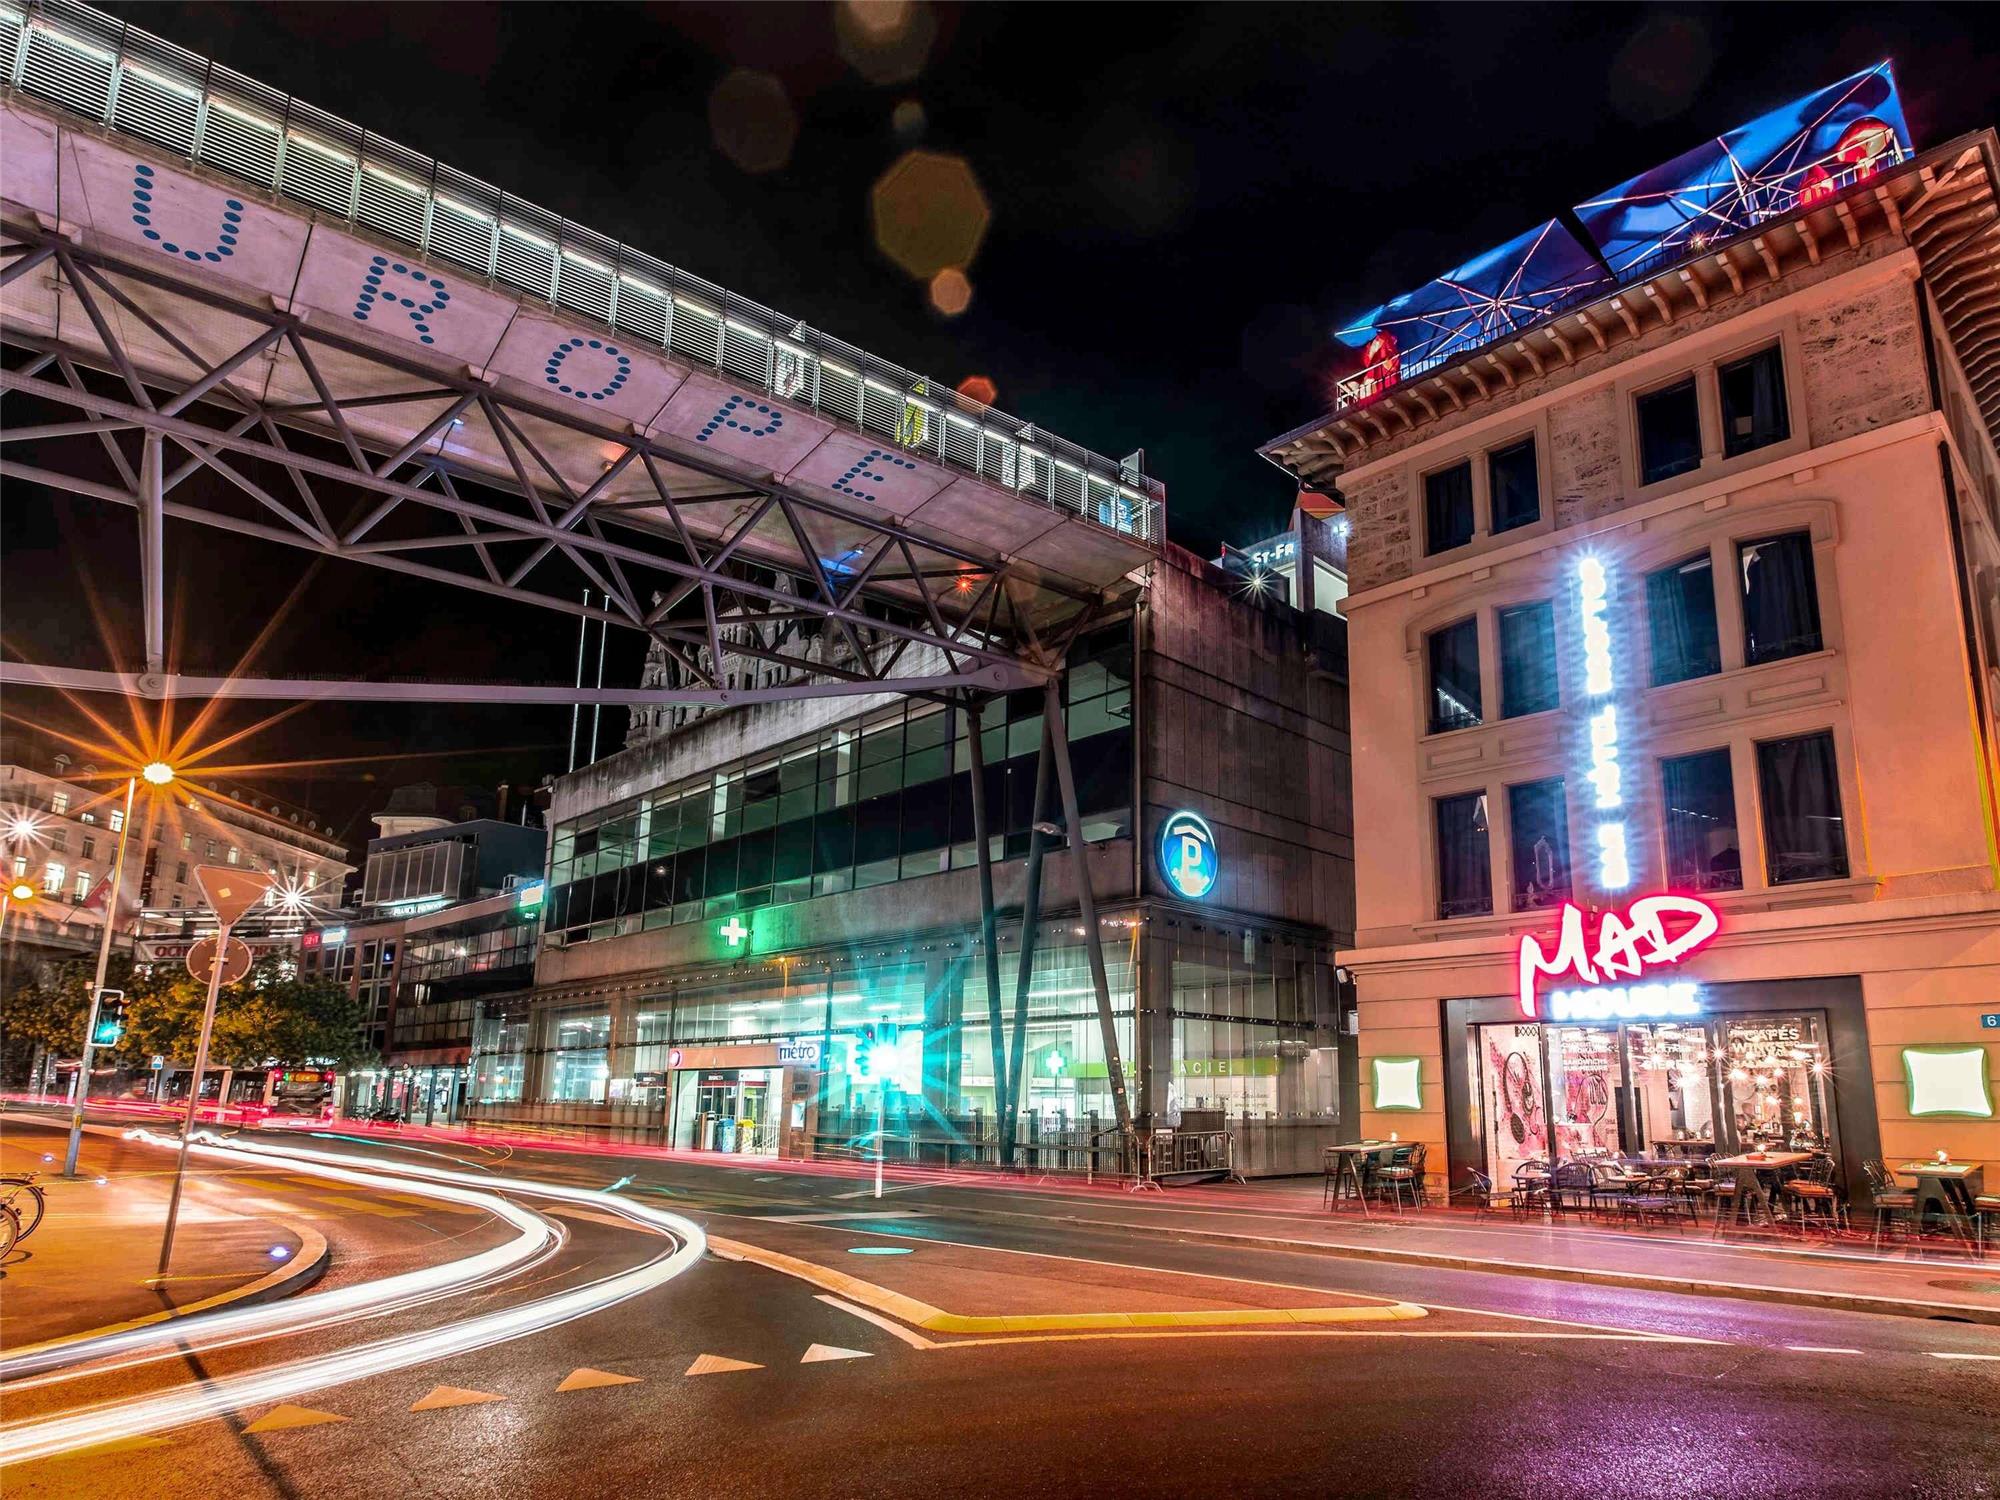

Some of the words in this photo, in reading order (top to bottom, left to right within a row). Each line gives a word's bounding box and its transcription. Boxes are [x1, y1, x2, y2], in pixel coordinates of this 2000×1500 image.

[1519, 895, 1719, 1018] MAD
[1986, 1015, 1998, 1027] 6
[779, 1041, 817, 1062] métro
